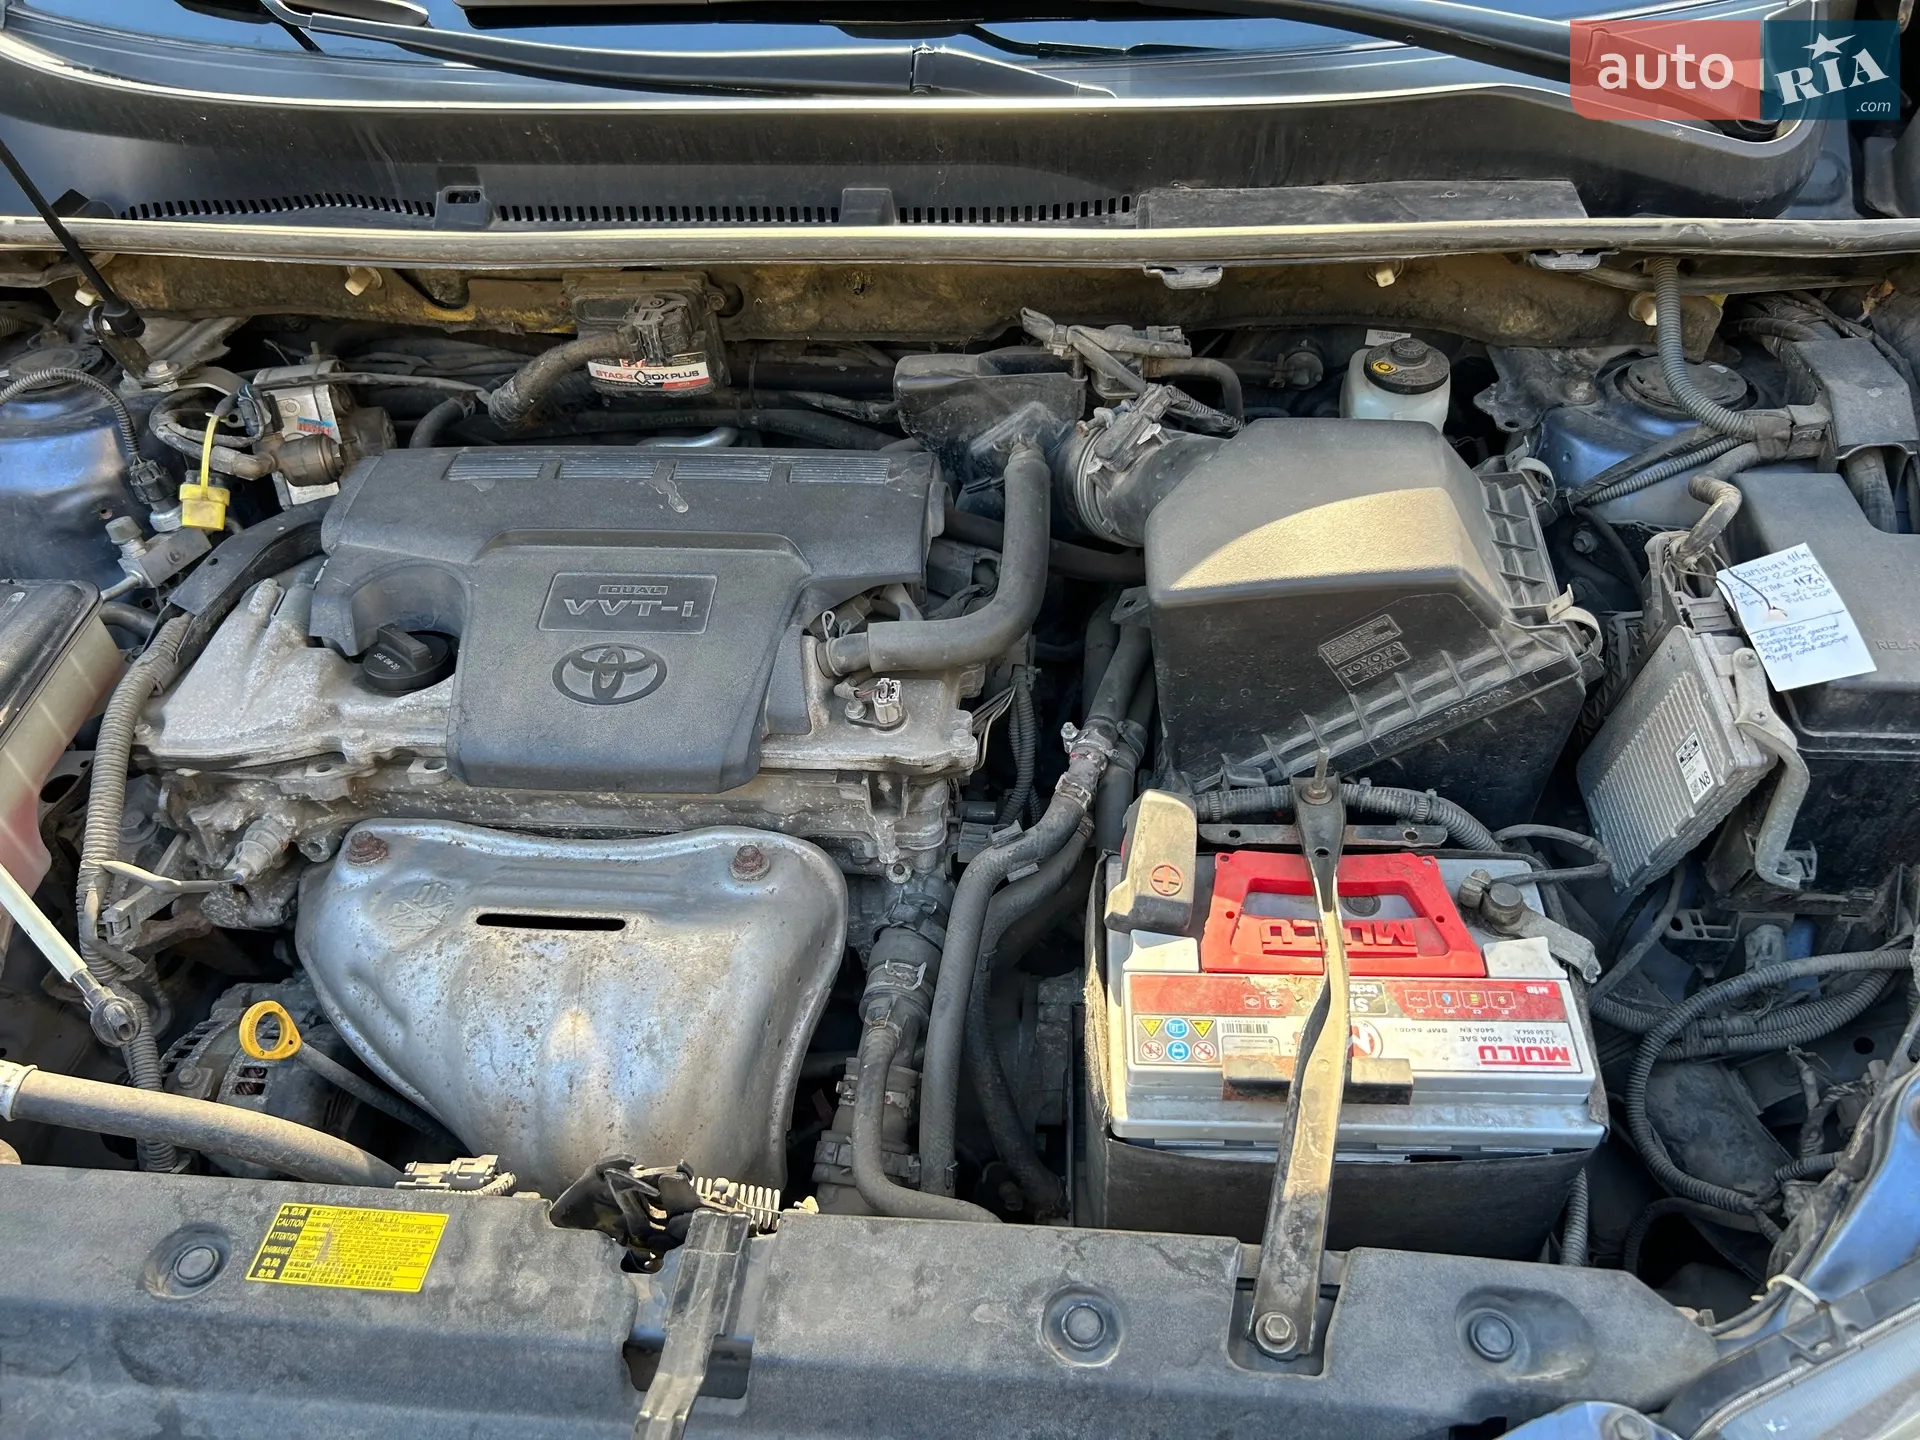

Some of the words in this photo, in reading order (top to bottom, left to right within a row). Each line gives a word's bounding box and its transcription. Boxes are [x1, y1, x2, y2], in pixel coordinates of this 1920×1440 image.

[595, 369, 634, 380] STAG-4
[670, 370, 699, 379] PLUS
[607, 585, 662, 595] DUAL
[563, 598, 696, 618] VVT-i
[1875, 640, 1920, 651] RELAY
[1345, 644, 1402, 675] TOYOTA
[1699, 771, 1711, 790] N8
[1260, 919, 1417, 957] MULU
[1480, 1035, 1503, 1043] 600A
[1513, 1035, 1537, 1045] 60Ah
[1540, 1036, 1556, 1044] 12V
[1478, 1045, 1572, 1067] MUTLU
[276, 1217, 306, 1228] CAUTION
[269, 1231, 300, 1241] ATTENTION
